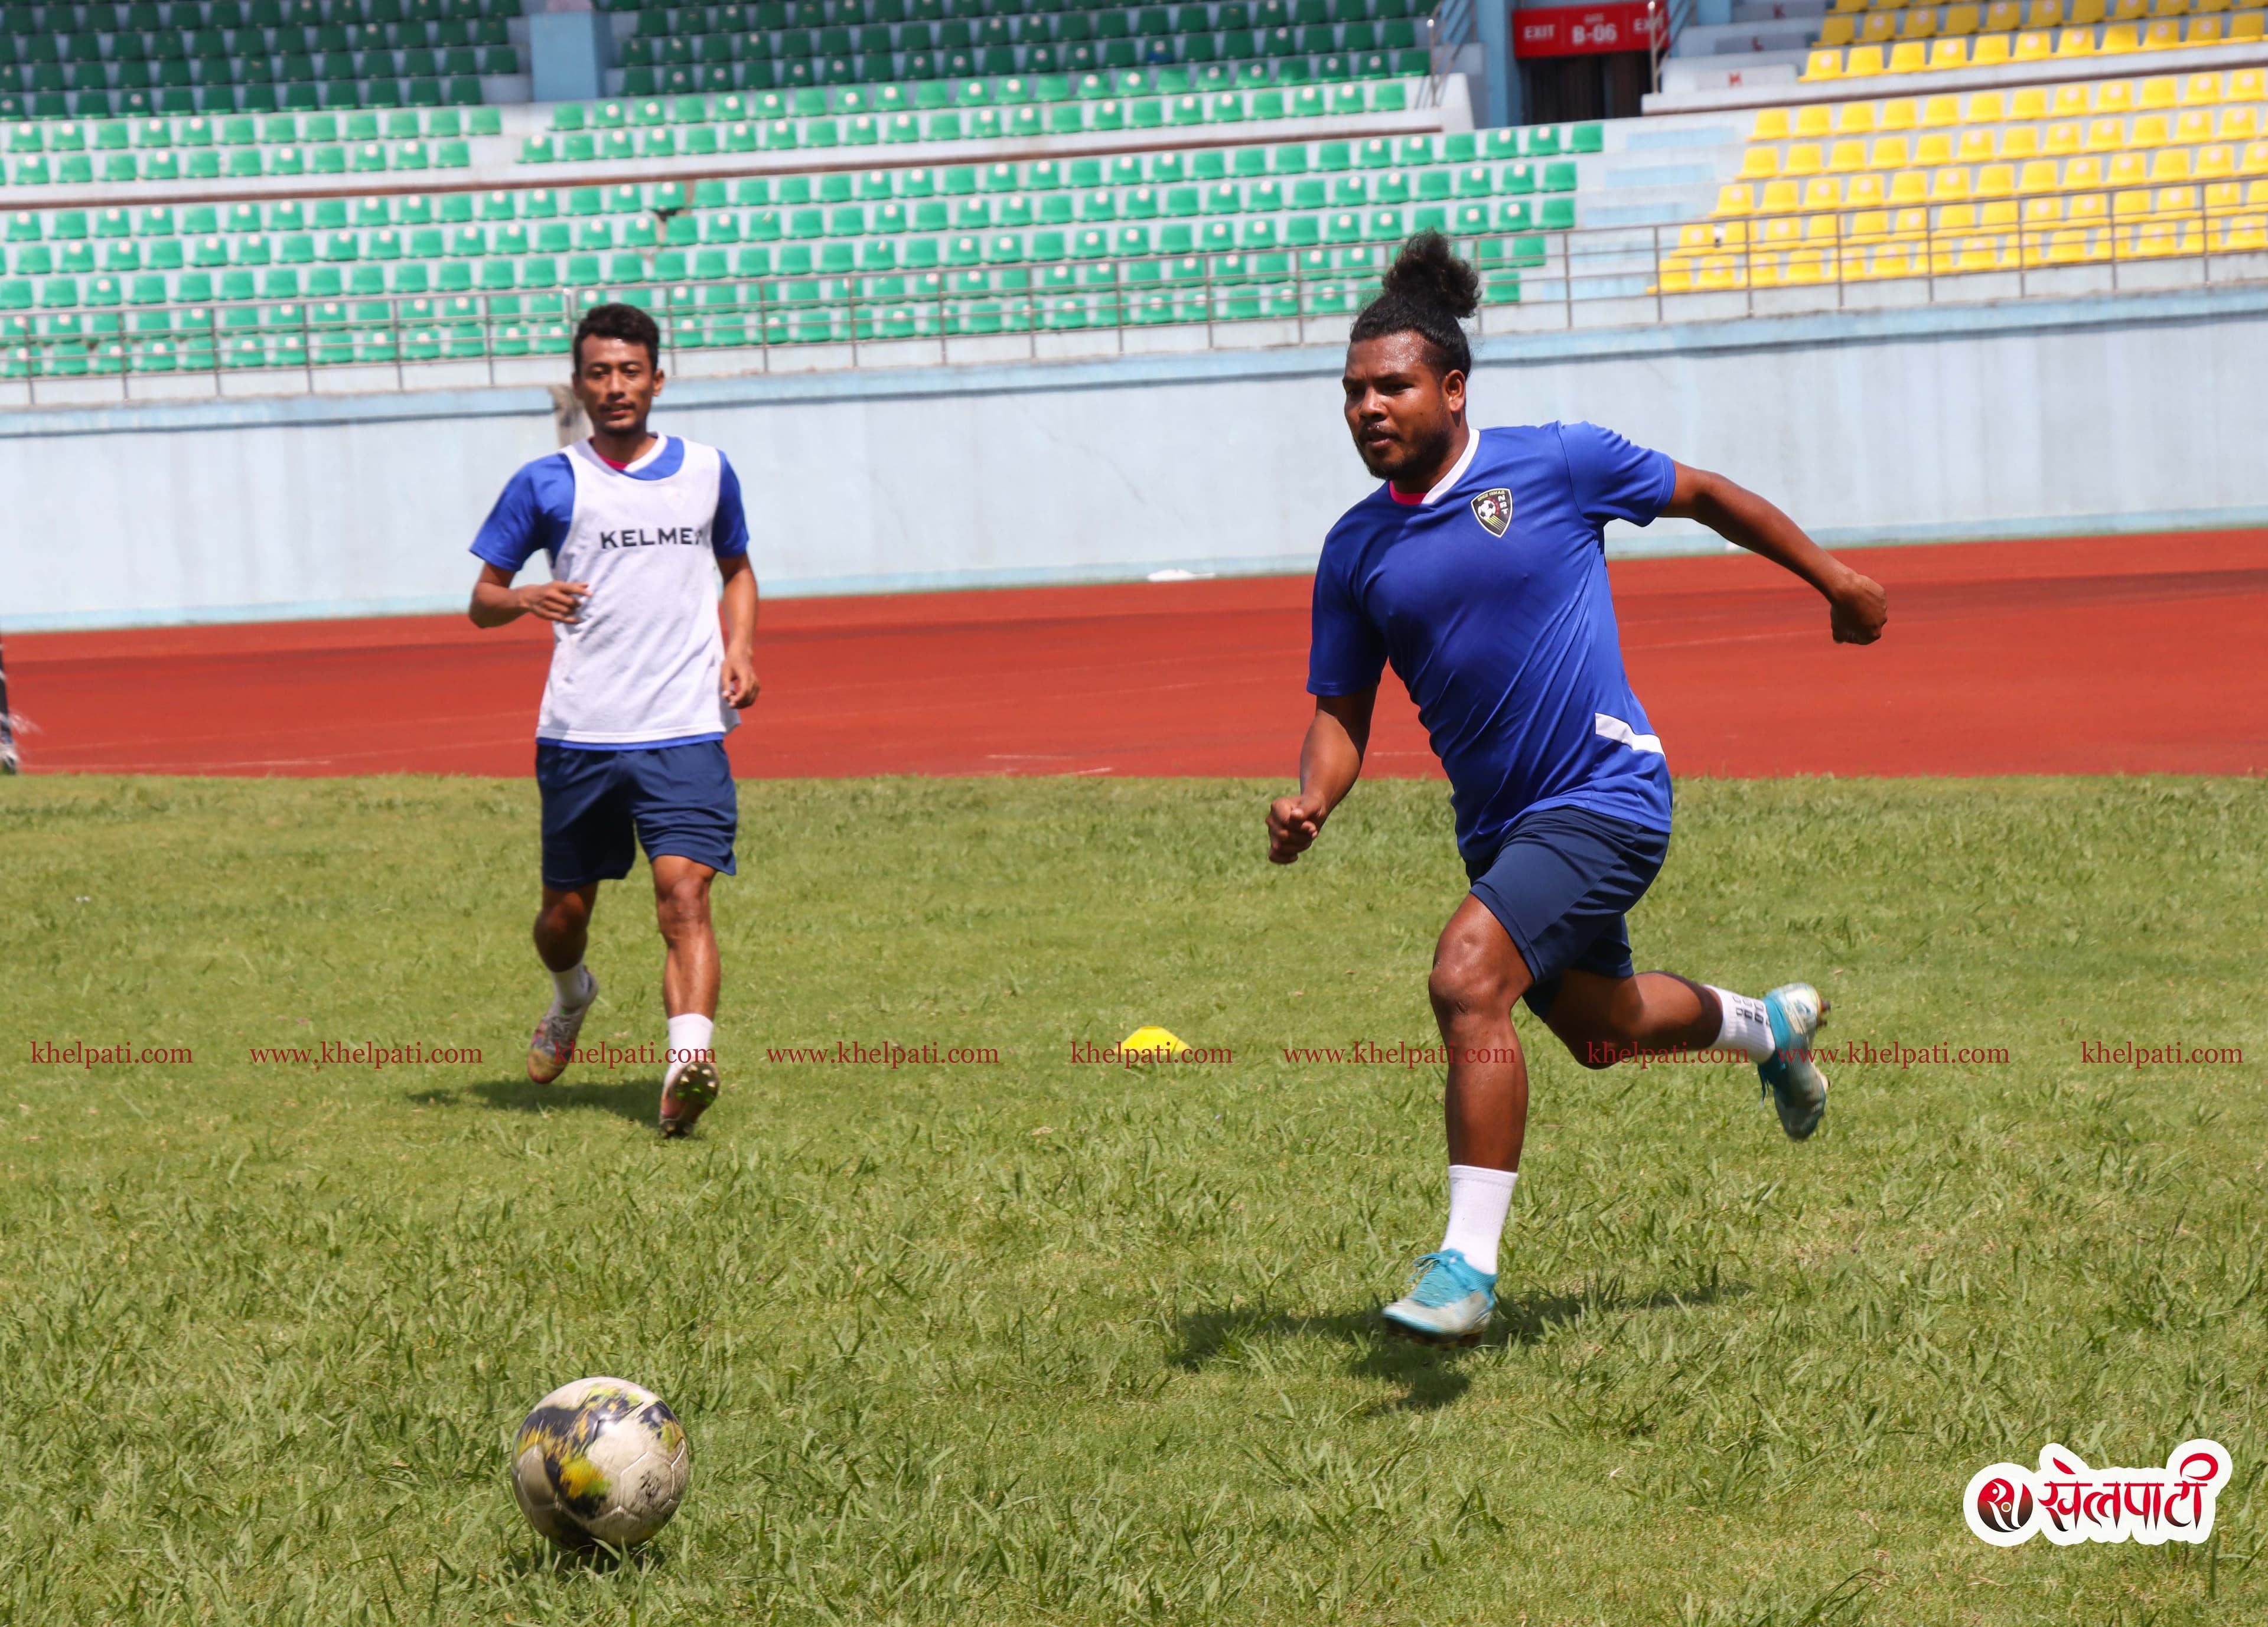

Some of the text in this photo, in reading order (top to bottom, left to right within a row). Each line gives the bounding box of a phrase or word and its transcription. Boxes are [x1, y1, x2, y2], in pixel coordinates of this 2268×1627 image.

[1524, 25, 1556, 41] EXIT
[1634, 17, 1664, 34] EXT
[1572, 24, 1617, 45] B-06
